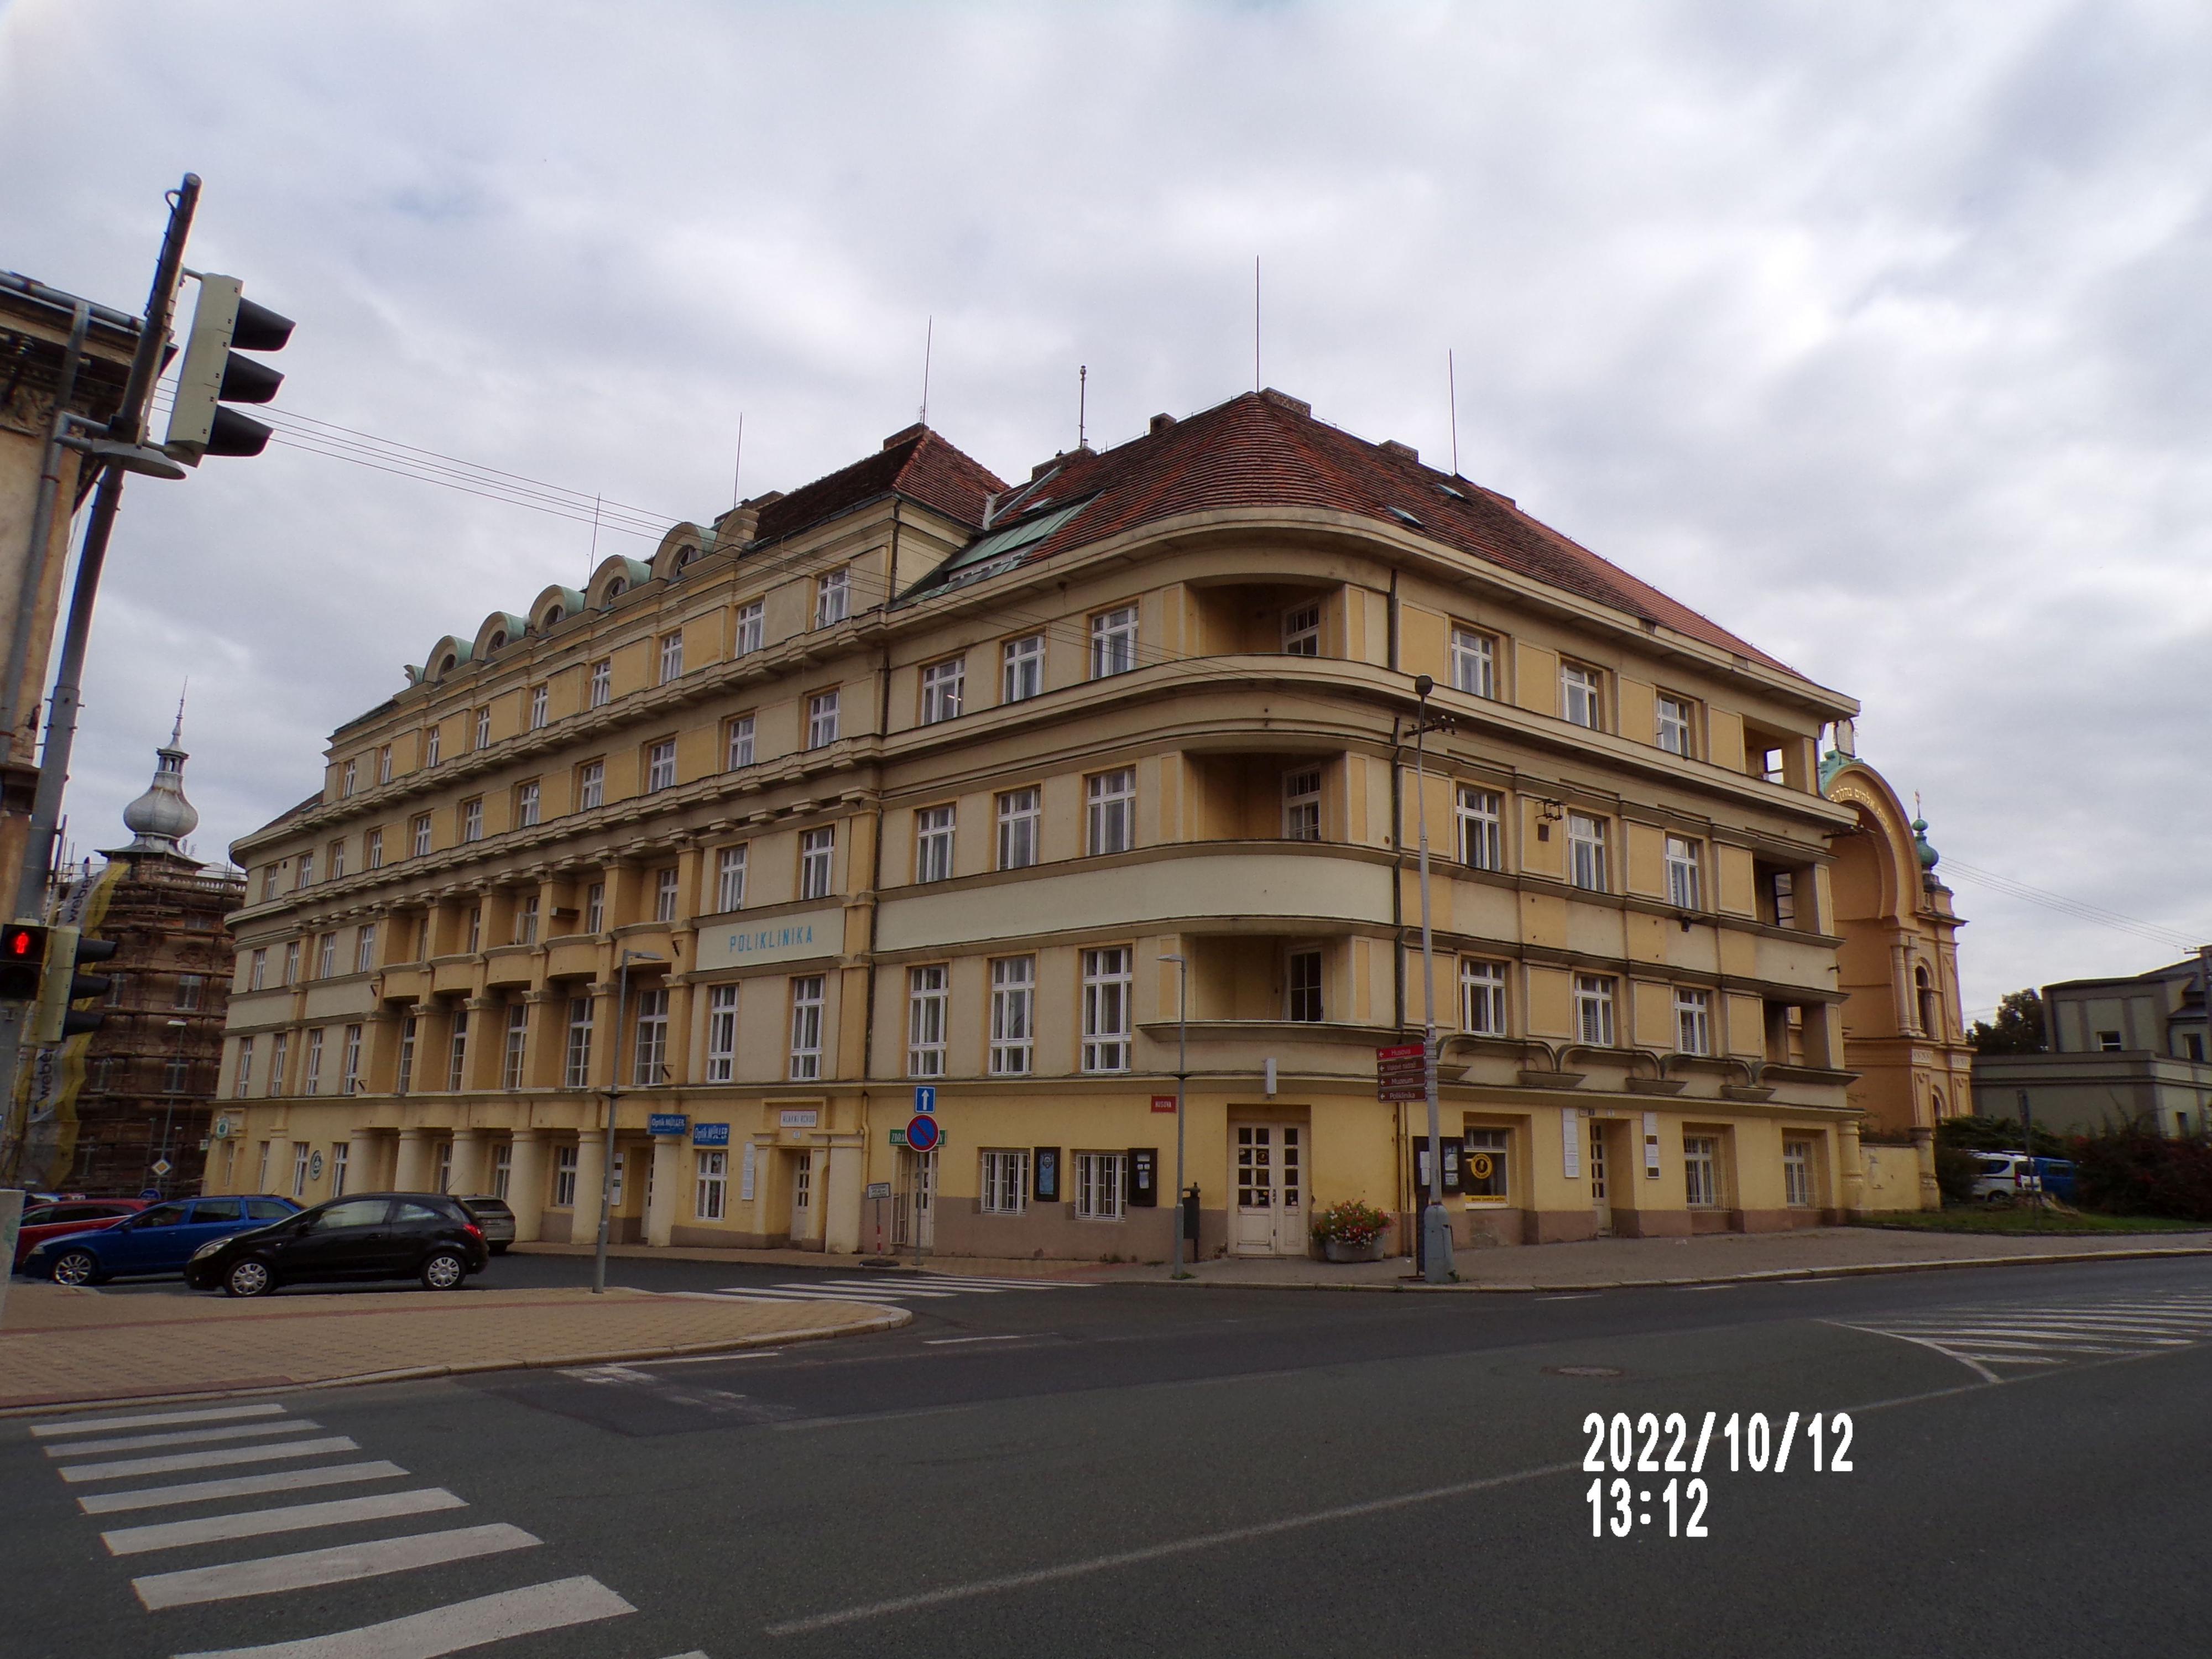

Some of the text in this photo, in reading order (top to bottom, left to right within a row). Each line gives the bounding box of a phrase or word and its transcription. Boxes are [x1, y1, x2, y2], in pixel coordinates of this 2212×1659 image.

[68, 872, 95, 922] weber
[729, 925, 812, 953] POLIKLINIKA
[651, 1118, 664, 1127] Optik
